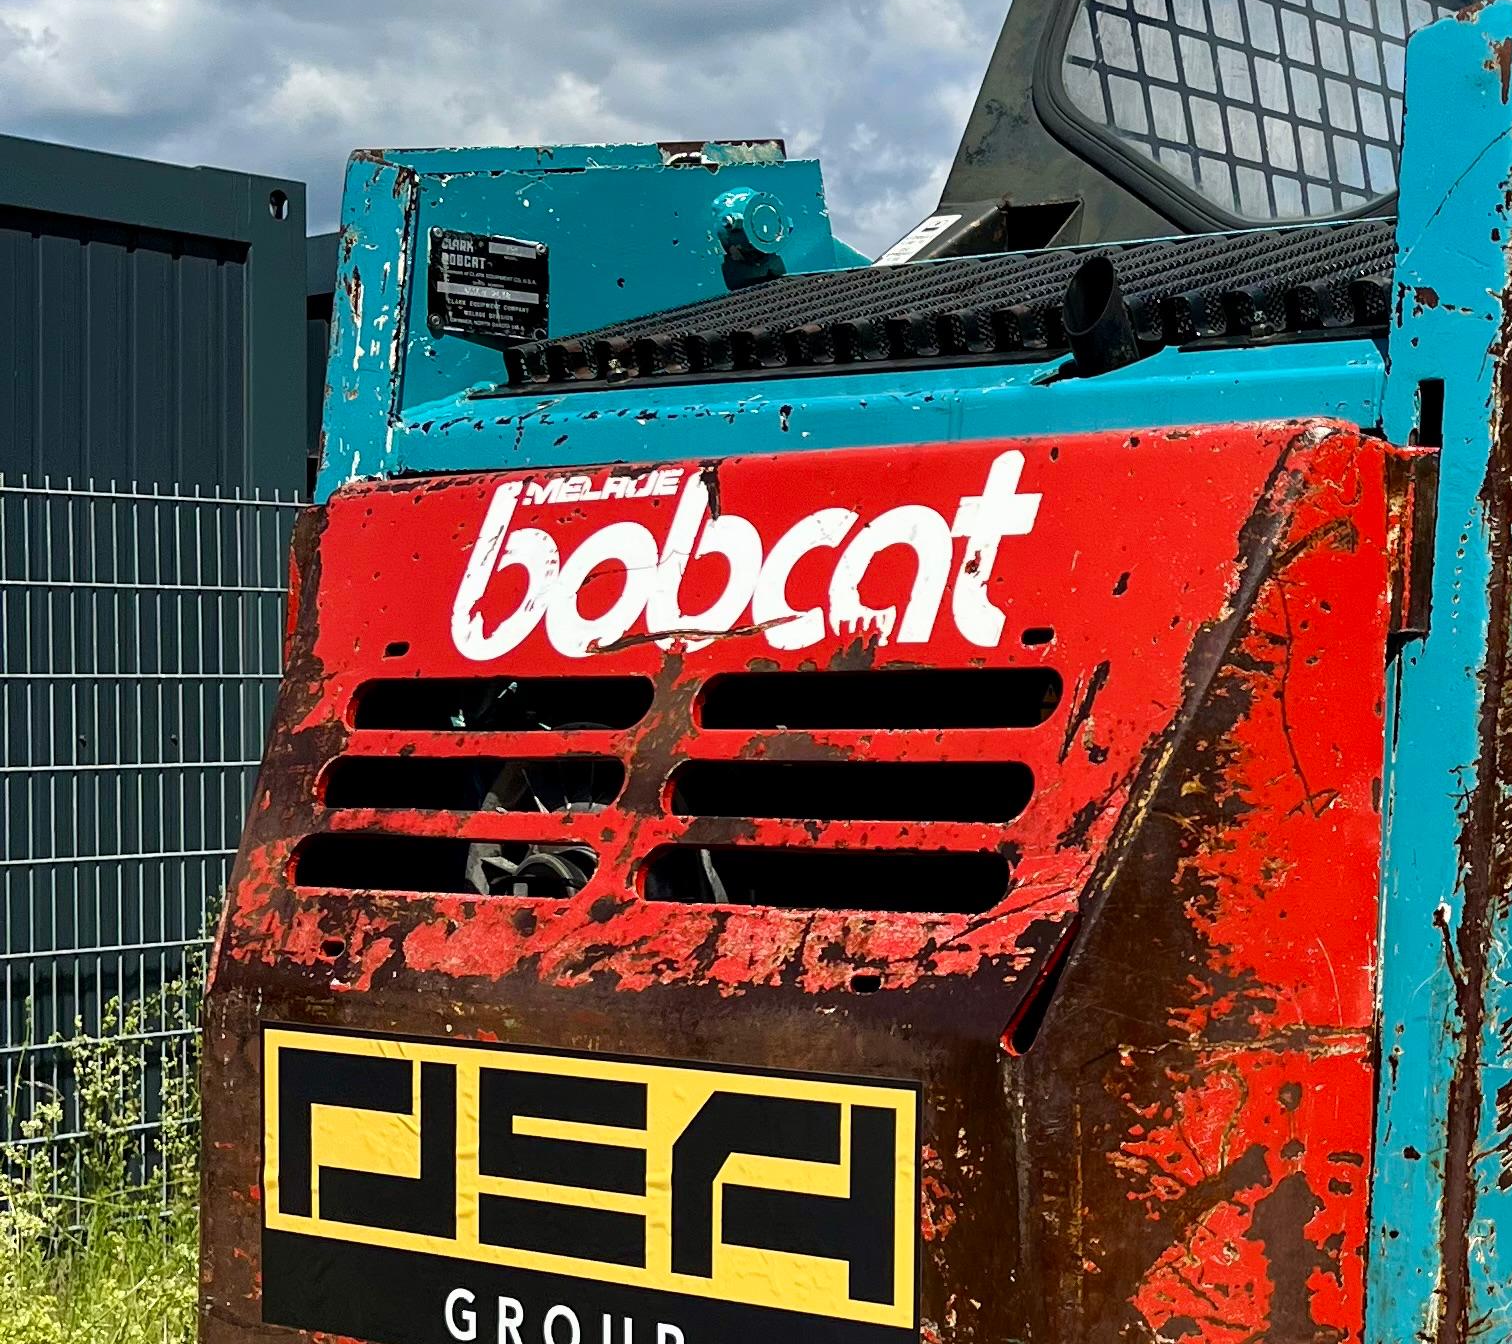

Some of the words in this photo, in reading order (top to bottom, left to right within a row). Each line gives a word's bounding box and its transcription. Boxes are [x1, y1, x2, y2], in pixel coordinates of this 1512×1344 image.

[441, 237, 474, 253] CLARK
[441, 252, 487, 270] BOBCAT
[450, 449, 1043, 662] bobcat
